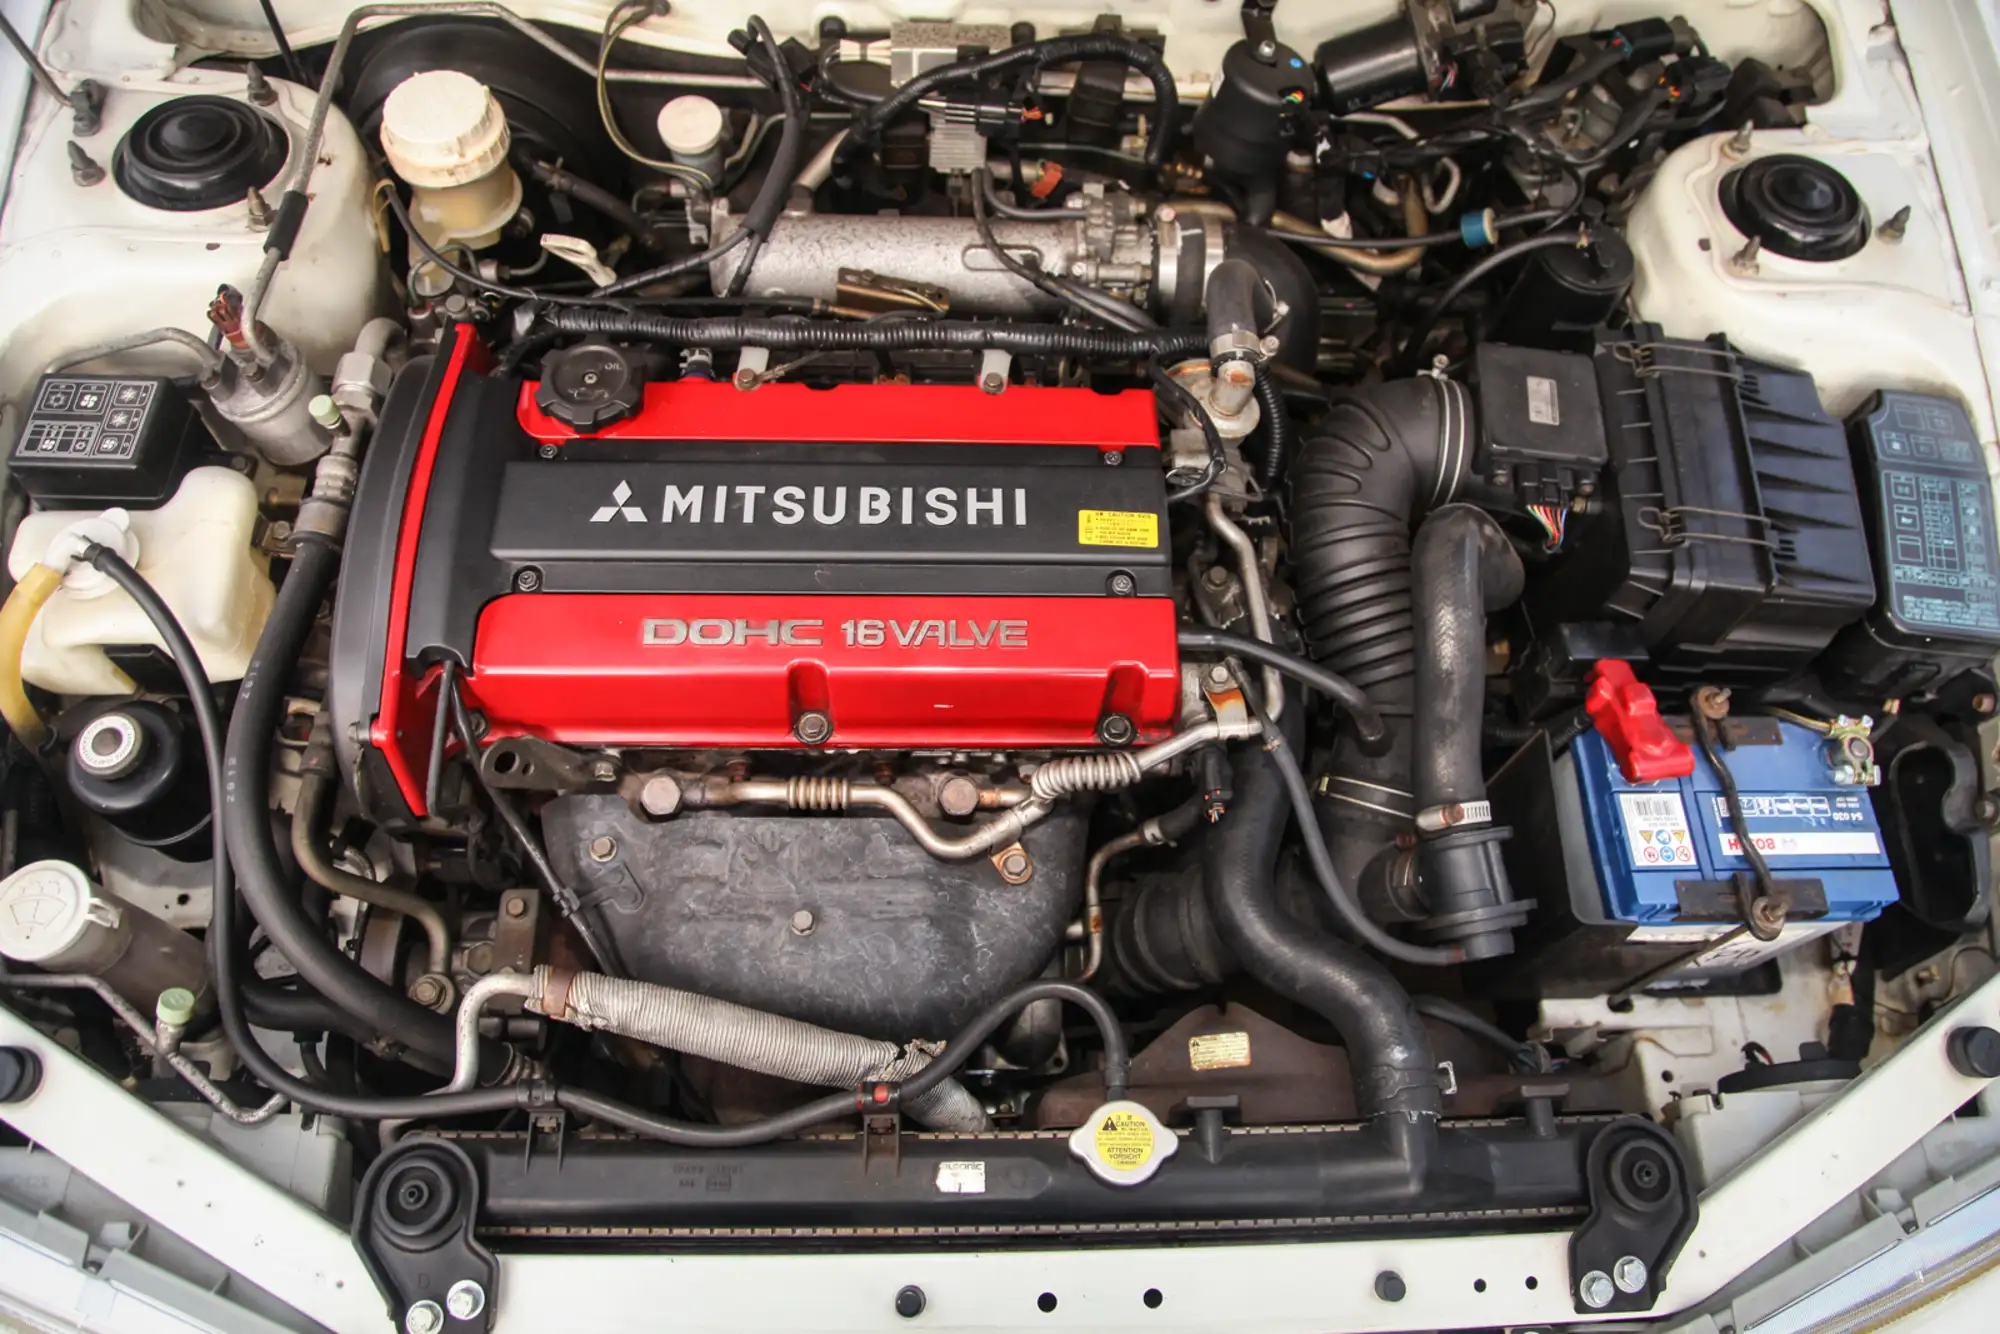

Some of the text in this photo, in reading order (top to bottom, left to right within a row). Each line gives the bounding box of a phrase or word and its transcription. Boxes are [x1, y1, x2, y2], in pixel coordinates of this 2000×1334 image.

[604, 361, 622, 371] OIL
[661, 485, 1028, 526] MITSUBISHI
[642, 618, 825, 646] DOHC
[1727, 837, 1776, 851] BOH
